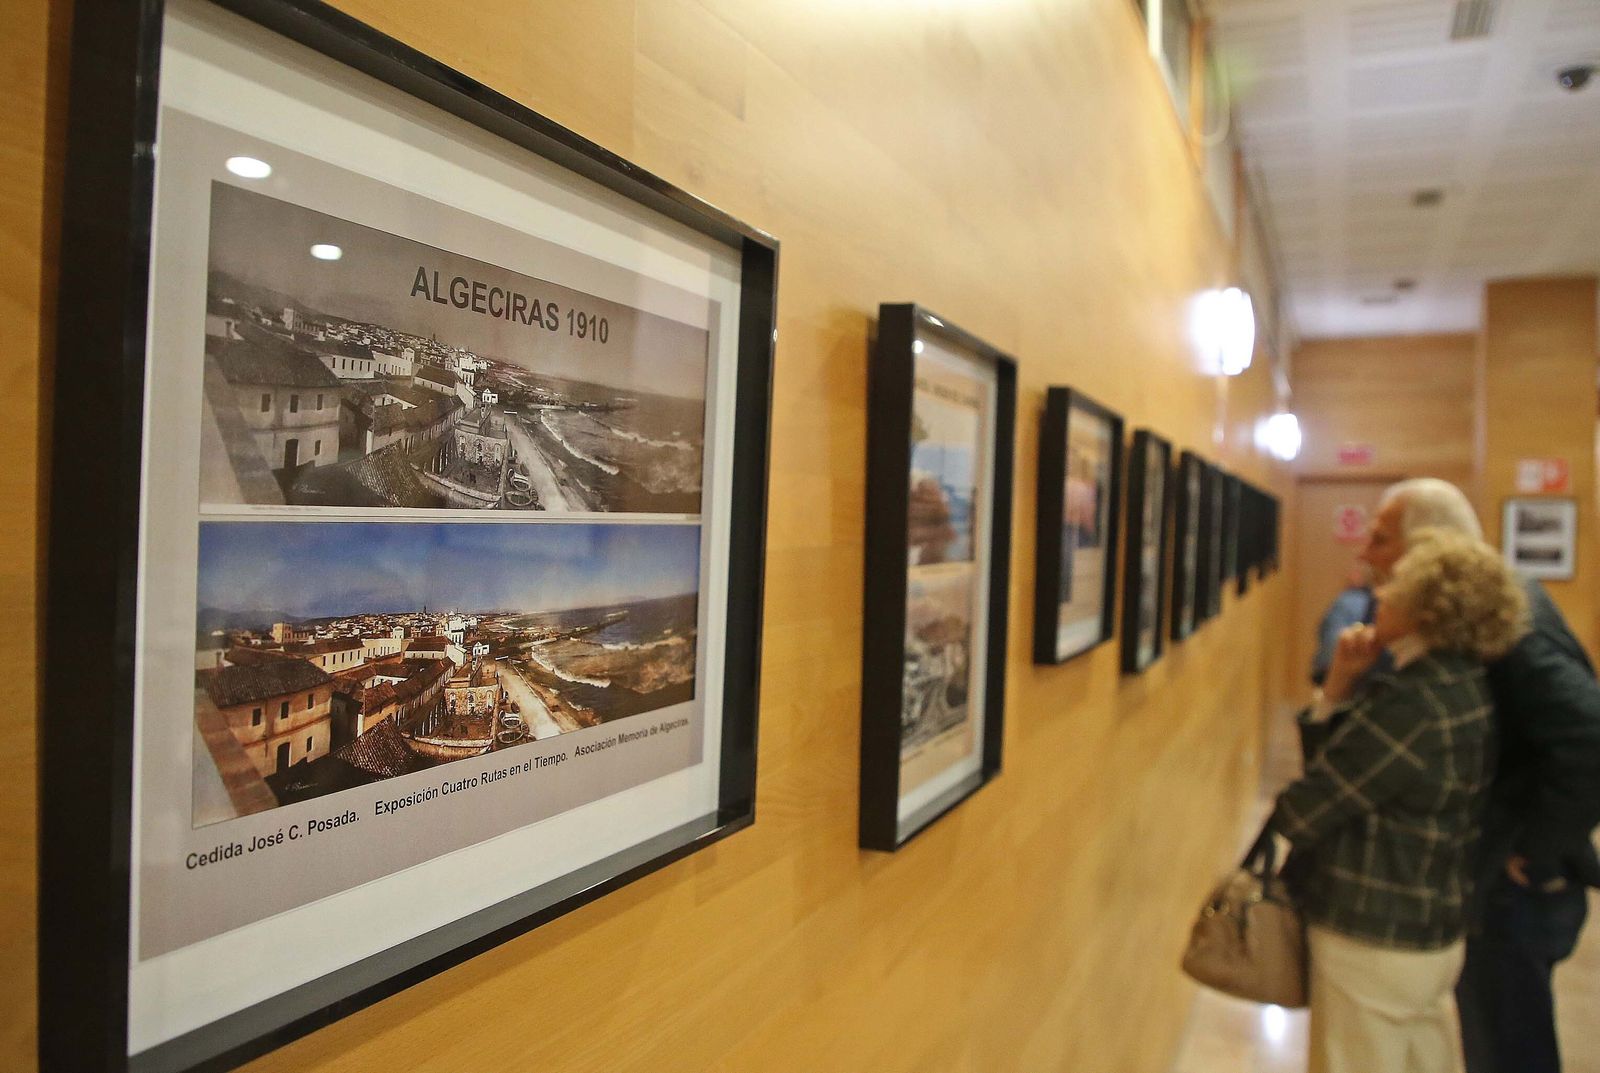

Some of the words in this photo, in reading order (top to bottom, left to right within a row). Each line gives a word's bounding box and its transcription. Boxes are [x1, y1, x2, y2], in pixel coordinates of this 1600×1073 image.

[410, 266, 560, 332] ALGECIRAS
[566, 308, 609, 344] 1910
[186, 841, 243, 870] Cedida
[248, 830, 284, 853] José
[288, 824, 303, 840] C.
[308, 809, 361, 835] Posada.
[375, 789, 439, 816] Exposición
[441, 777, 478, 796] Cuatro
[481, 769, 507, 785] Rutas
[509, 764, 521, 776] en
[523, 759, 532, 772] el
[534, 752, 569, 769] Tiempo.
[574, 737, 617, 758] Asociación
[618, 729, 649, 745] Memoria
[650, 726, 659, 736] de
